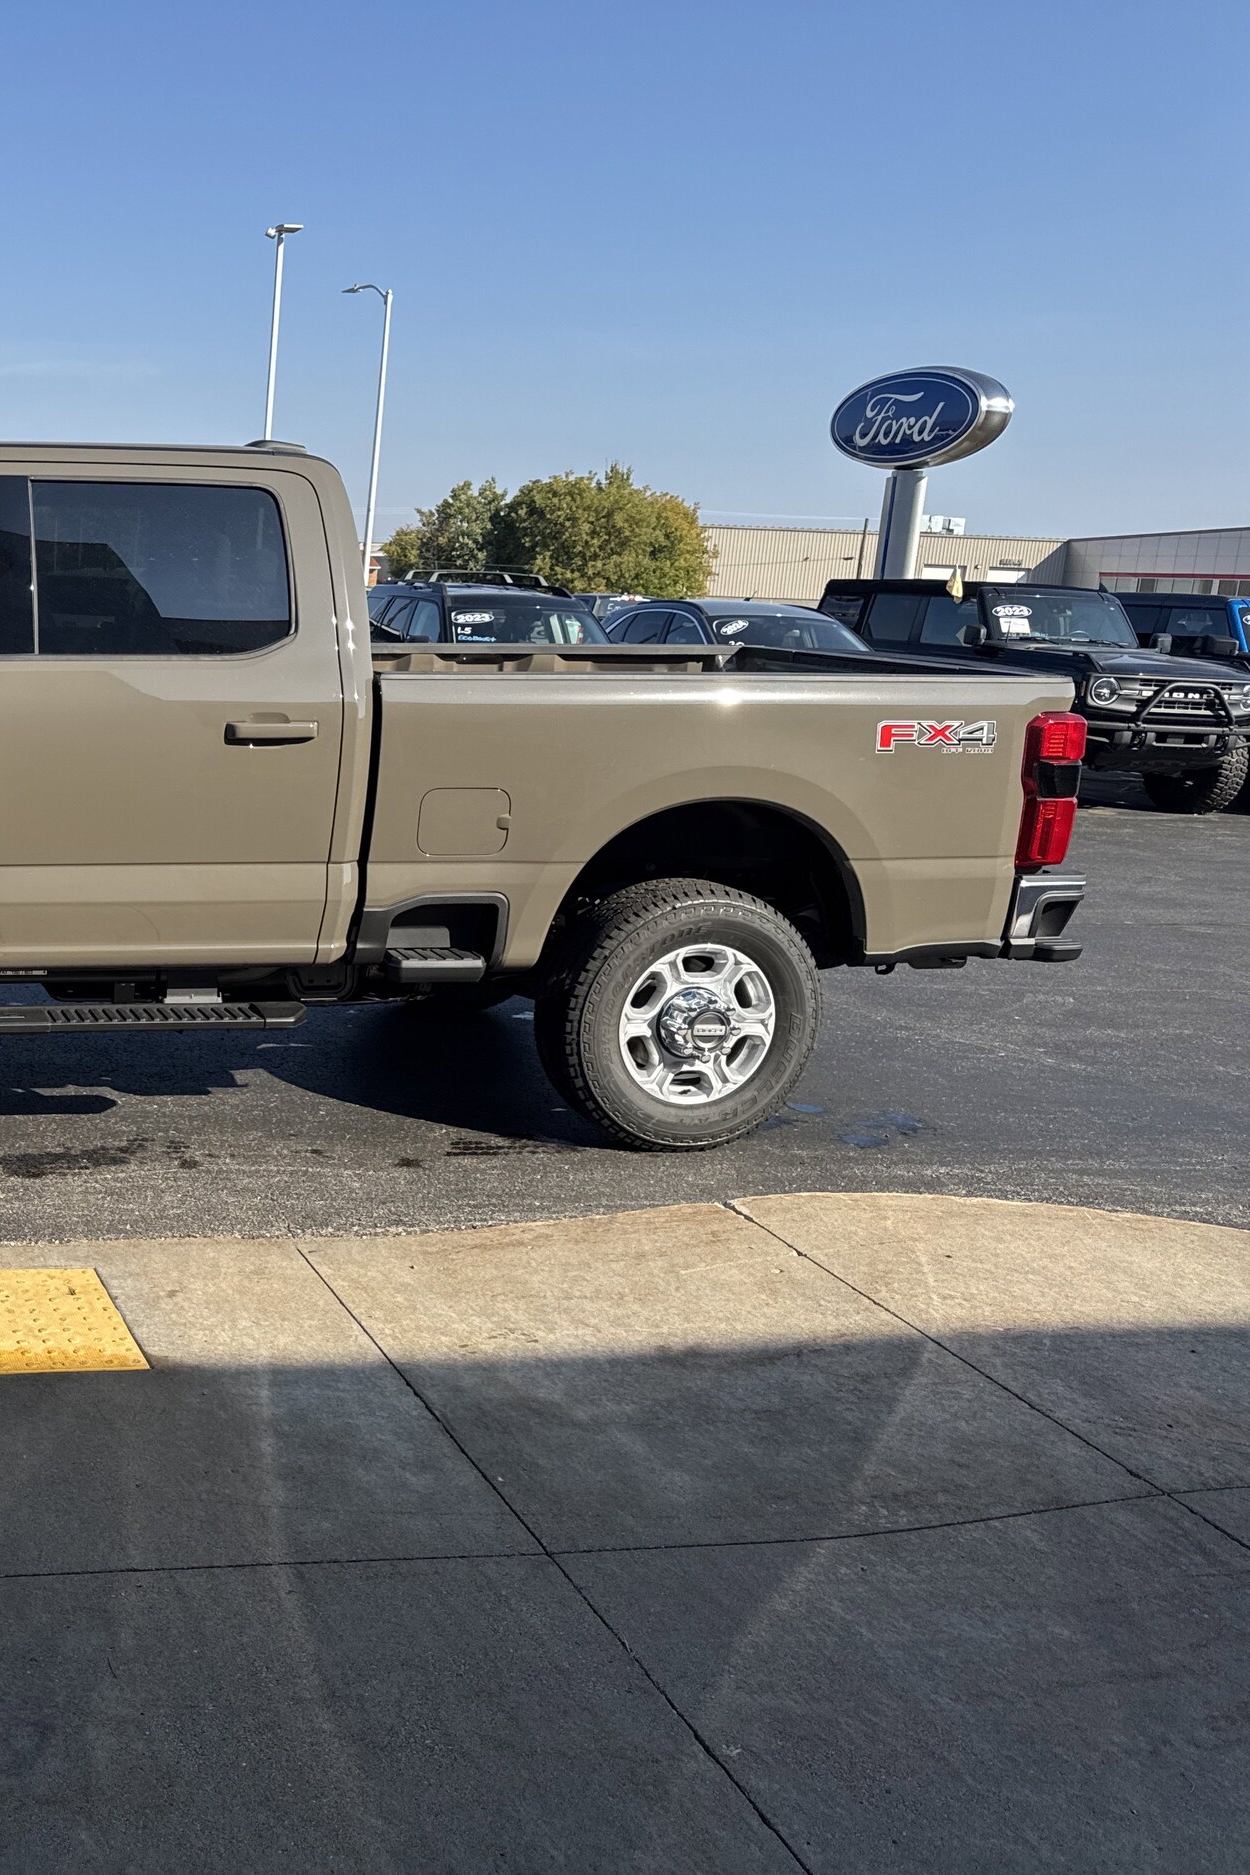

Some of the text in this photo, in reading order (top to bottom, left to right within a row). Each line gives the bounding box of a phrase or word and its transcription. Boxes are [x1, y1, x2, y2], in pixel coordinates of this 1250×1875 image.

[854, 391, 946, 447] Ford
[456, 613, 491, 623] 2023
[996, 607, 1029, 616] 2023
[876, 720, 997, 753] FX4
